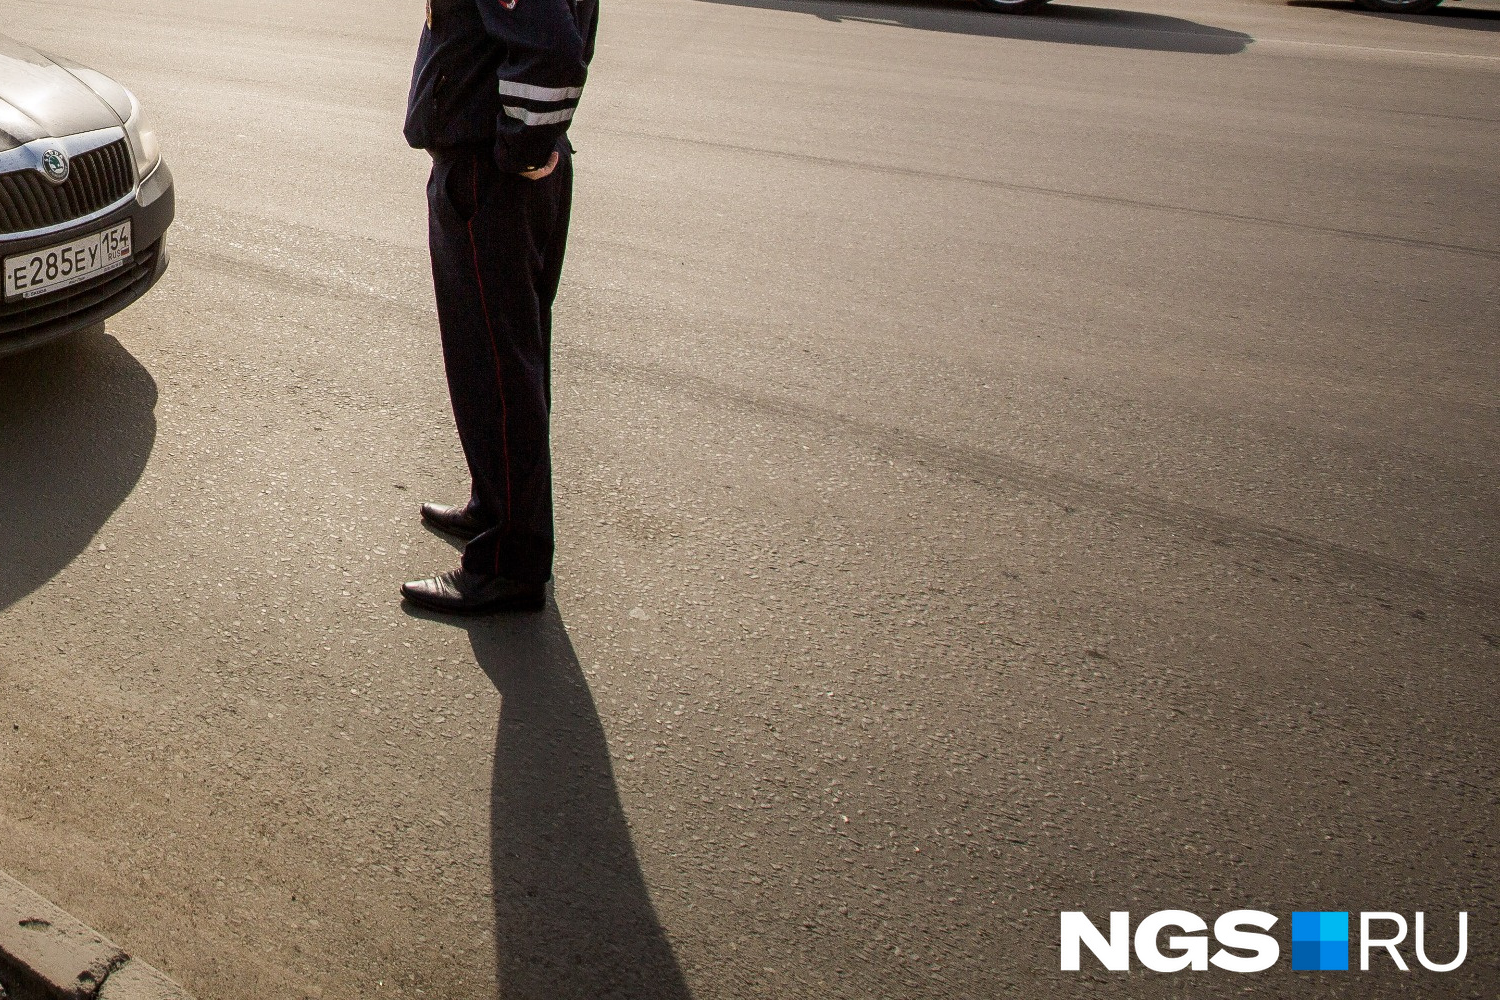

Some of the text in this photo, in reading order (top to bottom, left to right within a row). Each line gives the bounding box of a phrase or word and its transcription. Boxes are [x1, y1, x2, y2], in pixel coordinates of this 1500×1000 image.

[13, 226, 129, 291] Е285ЕУ 154
[107, 249, 121, 261] RUS
